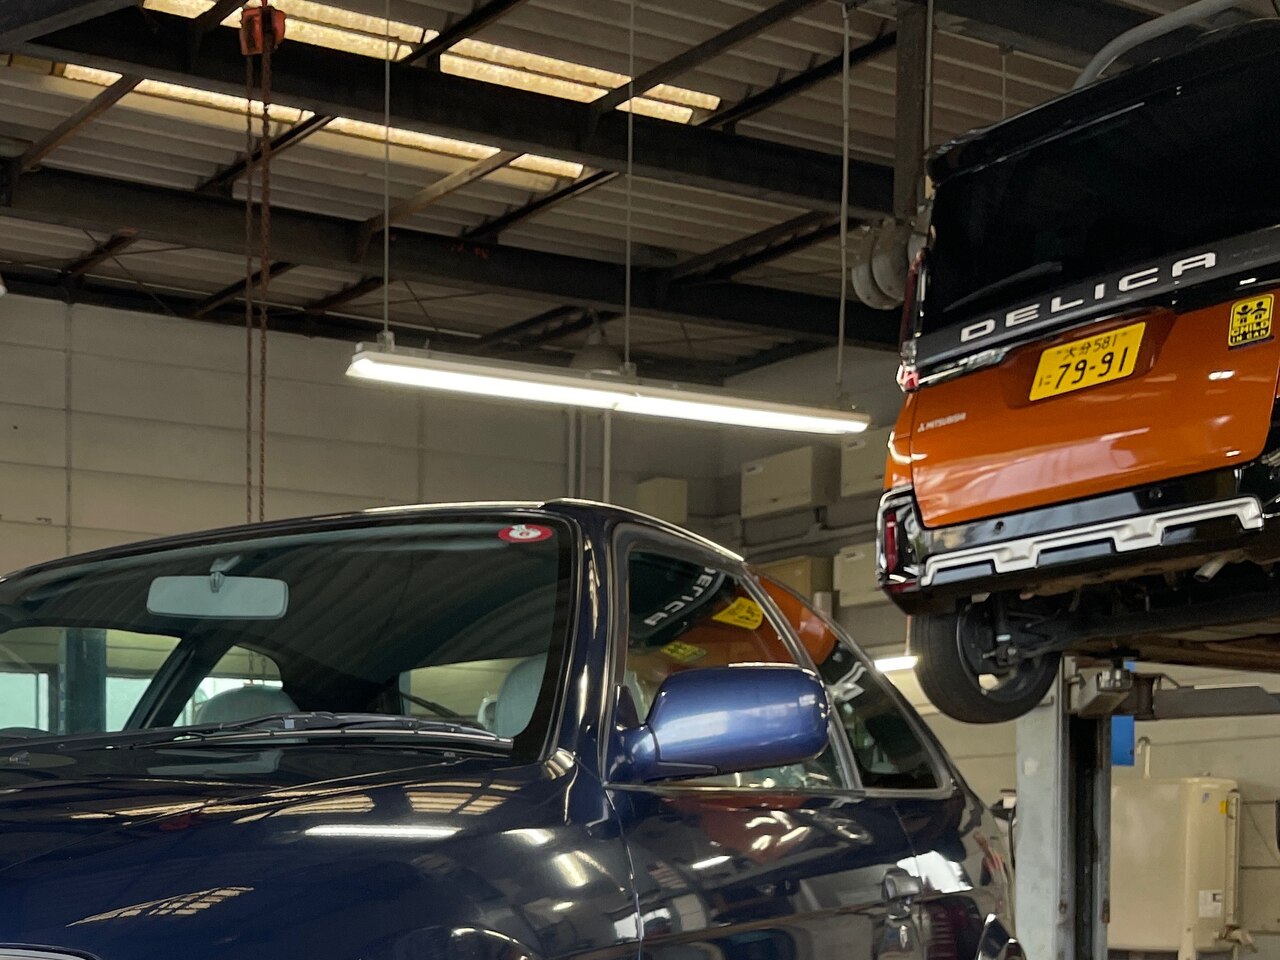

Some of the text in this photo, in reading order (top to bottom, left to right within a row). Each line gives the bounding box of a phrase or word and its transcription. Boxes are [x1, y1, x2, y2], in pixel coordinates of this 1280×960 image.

[960, 252, 1217, 343] DELICA
[1231, 320, 1269, 337] CHILD
[1232, 329, 1267, 343] IN CAR
[1093, 333, 1118, 353] 581
[1055, 346, 1129, 390] 79-91
